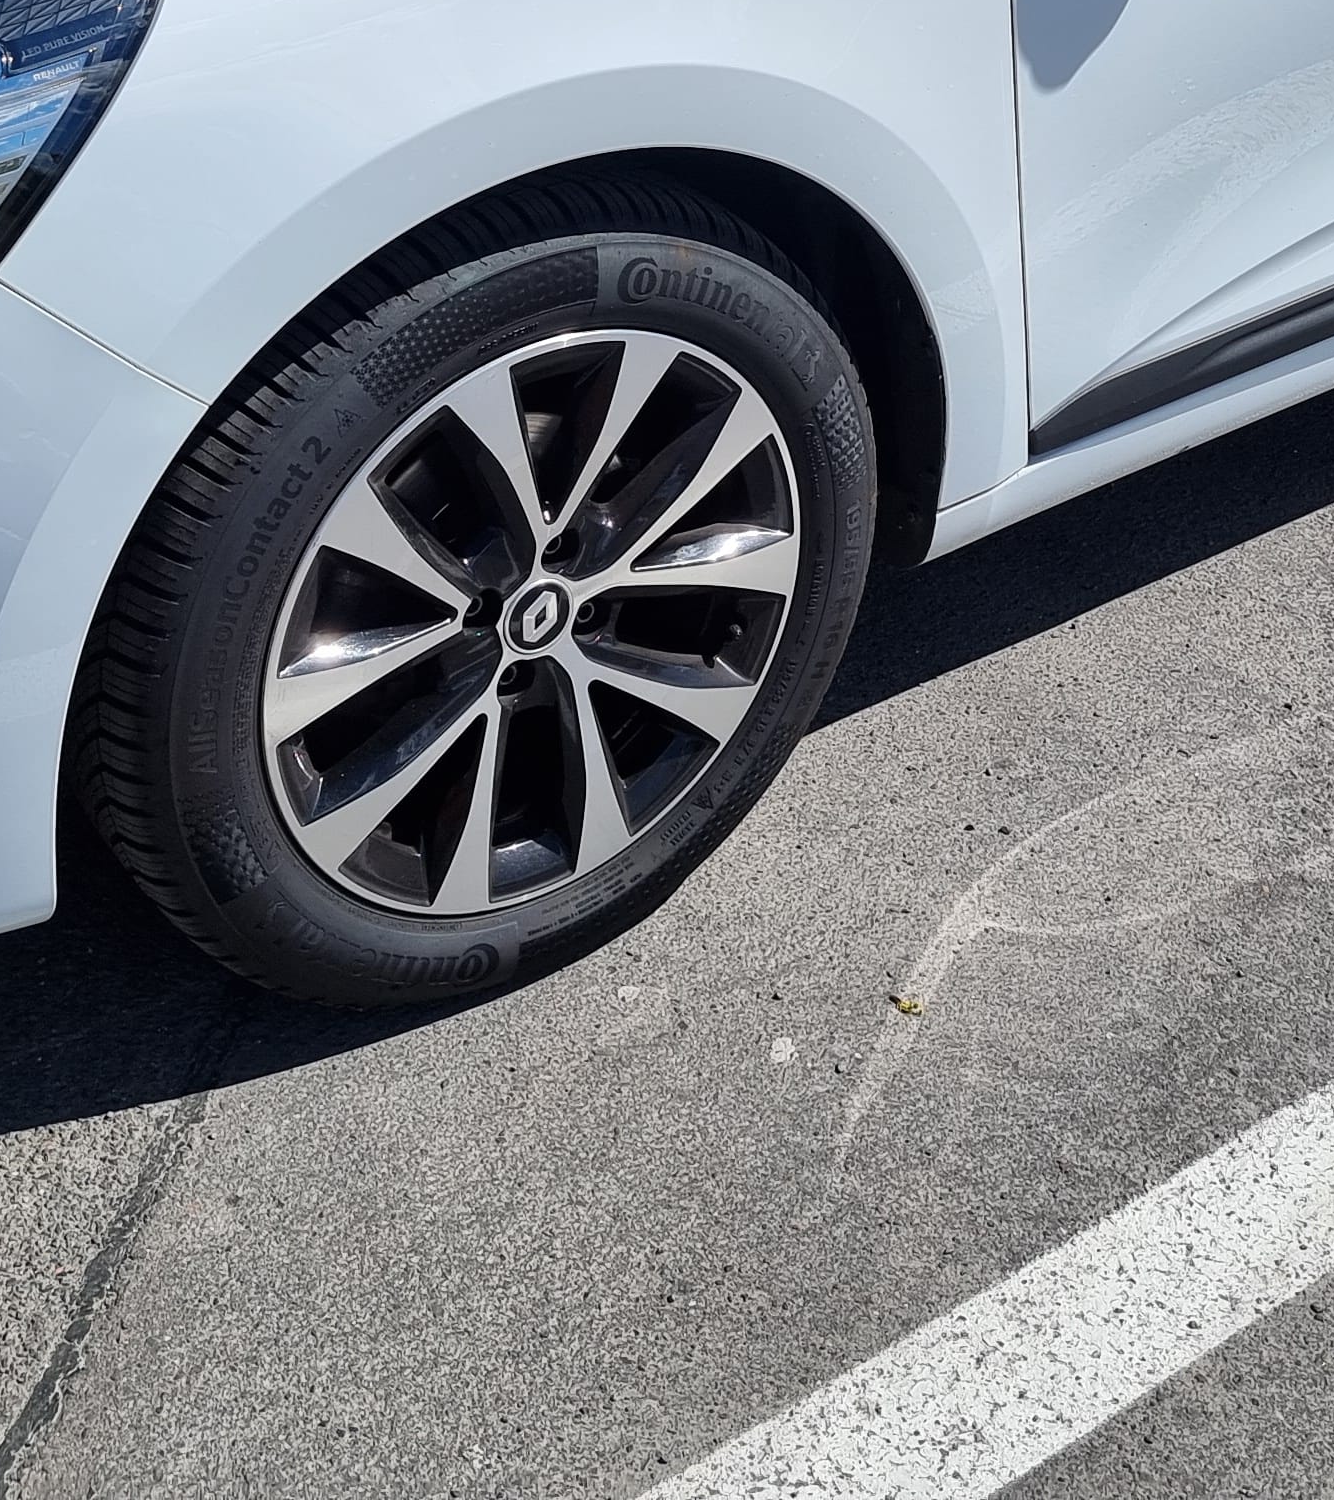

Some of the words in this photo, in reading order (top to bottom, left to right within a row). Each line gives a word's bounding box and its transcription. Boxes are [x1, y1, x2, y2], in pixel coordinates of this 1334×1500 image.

[22, 46, 42, 60] LED
[43, 36, 71, 52] PURE
[71, 24, 105, 42] VISION
[33, 60, 80, 81] RENAULT
